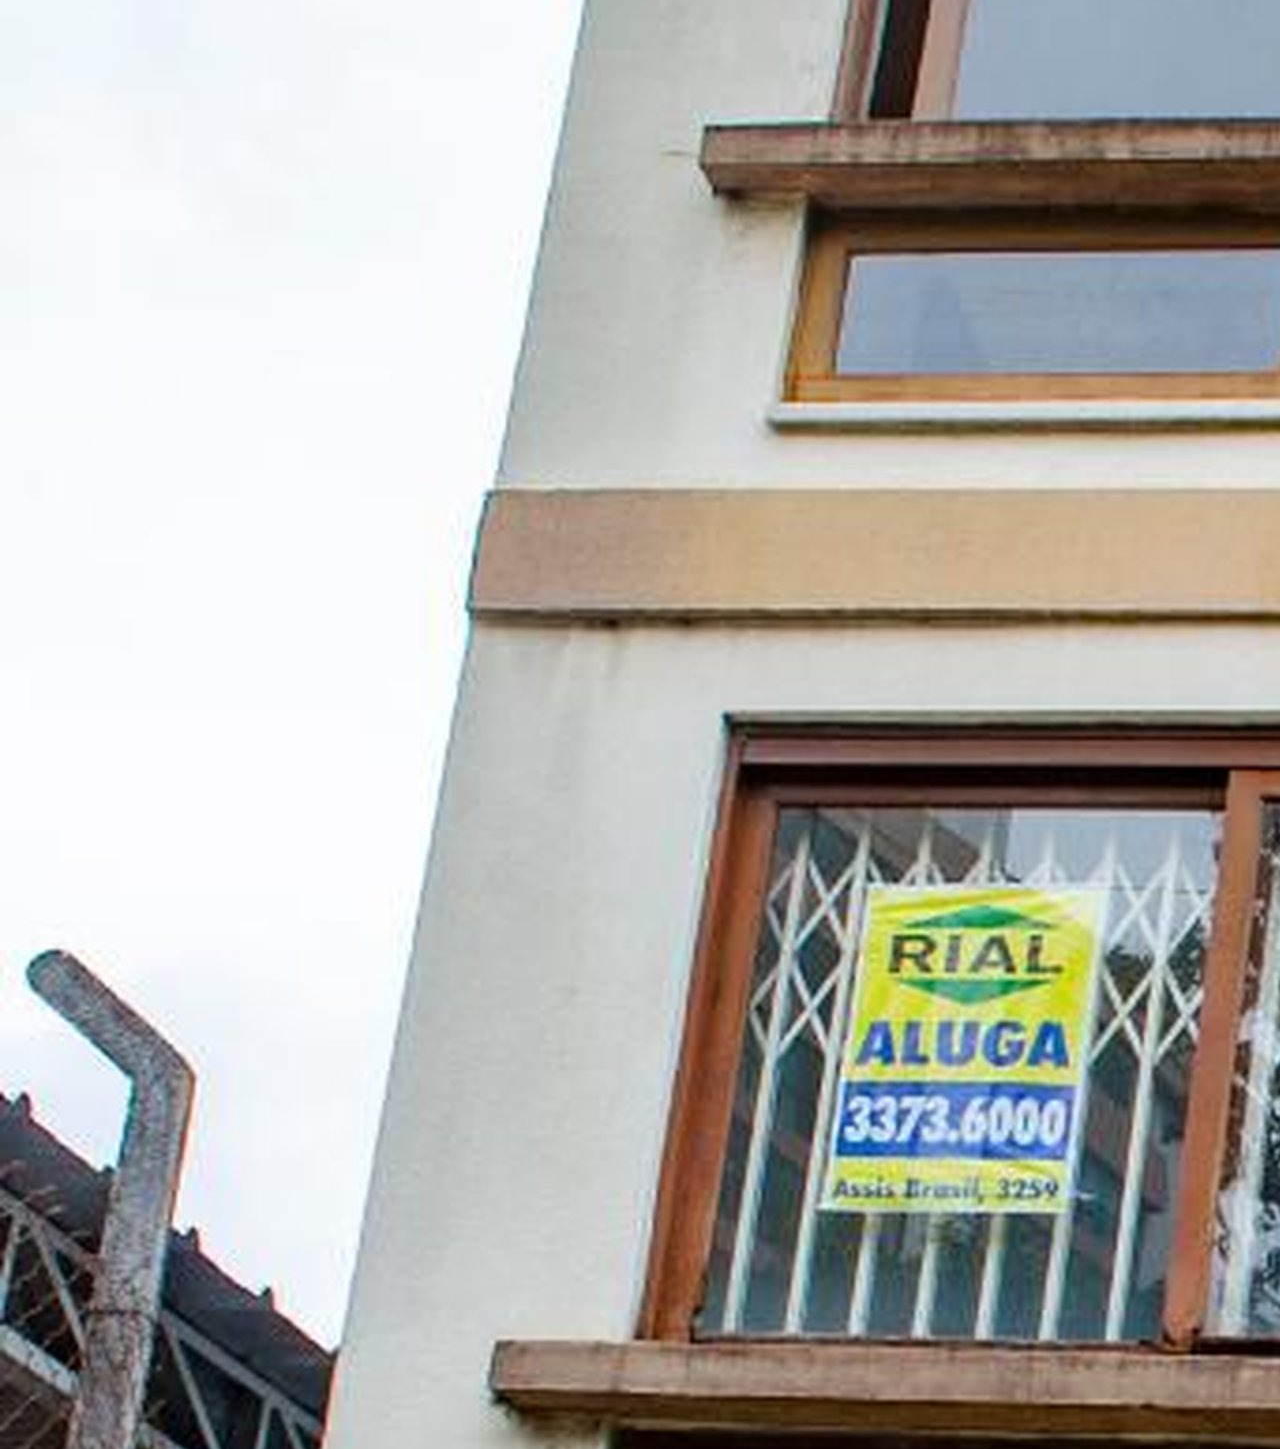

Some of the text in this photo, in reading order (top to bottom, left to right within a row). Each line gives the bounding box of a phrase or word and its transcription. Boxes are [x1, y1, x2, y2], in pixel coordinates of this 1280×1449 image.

[888, 934, 1063, 974] RIAL
[855, 1020, 1070, 1067] ALUGA
[844, 1095, 1066, 1147] 3373.6000
[833, 1177, 894, 1198] Assis
[997, 1178, 1058, 1199] 3259
